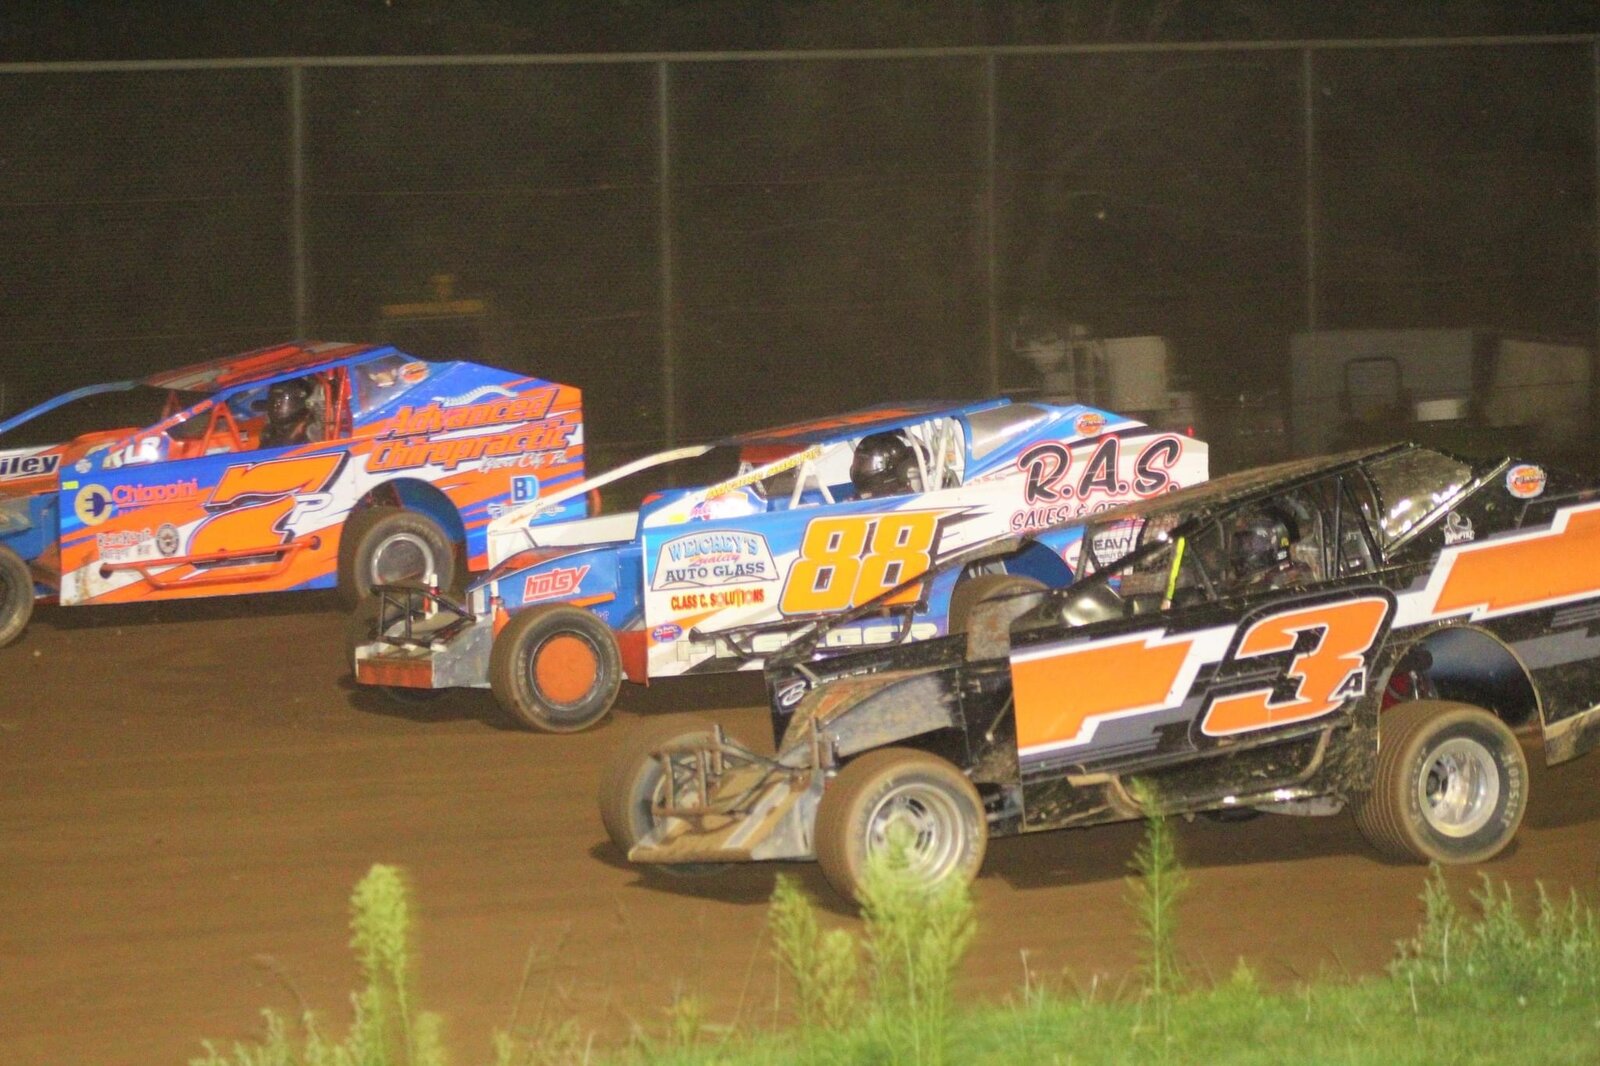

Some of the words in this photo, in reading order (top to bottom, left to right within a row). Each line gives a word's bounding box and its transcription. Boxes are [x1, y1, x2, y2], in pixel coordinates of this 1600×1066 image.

[378, 388, 559, 440] Advanced
[365, 417, 577, 473] Chiropractic
[1011, 505, 1070, 531] SALES
[1094, 537, 1131, 551] EAVY
[665, 567, 708, 582] AUTO
[713, 562, 765, 577] GLASS
[781, 511, 938, 615] 88
[526, 566, 589, 599] hotsy
